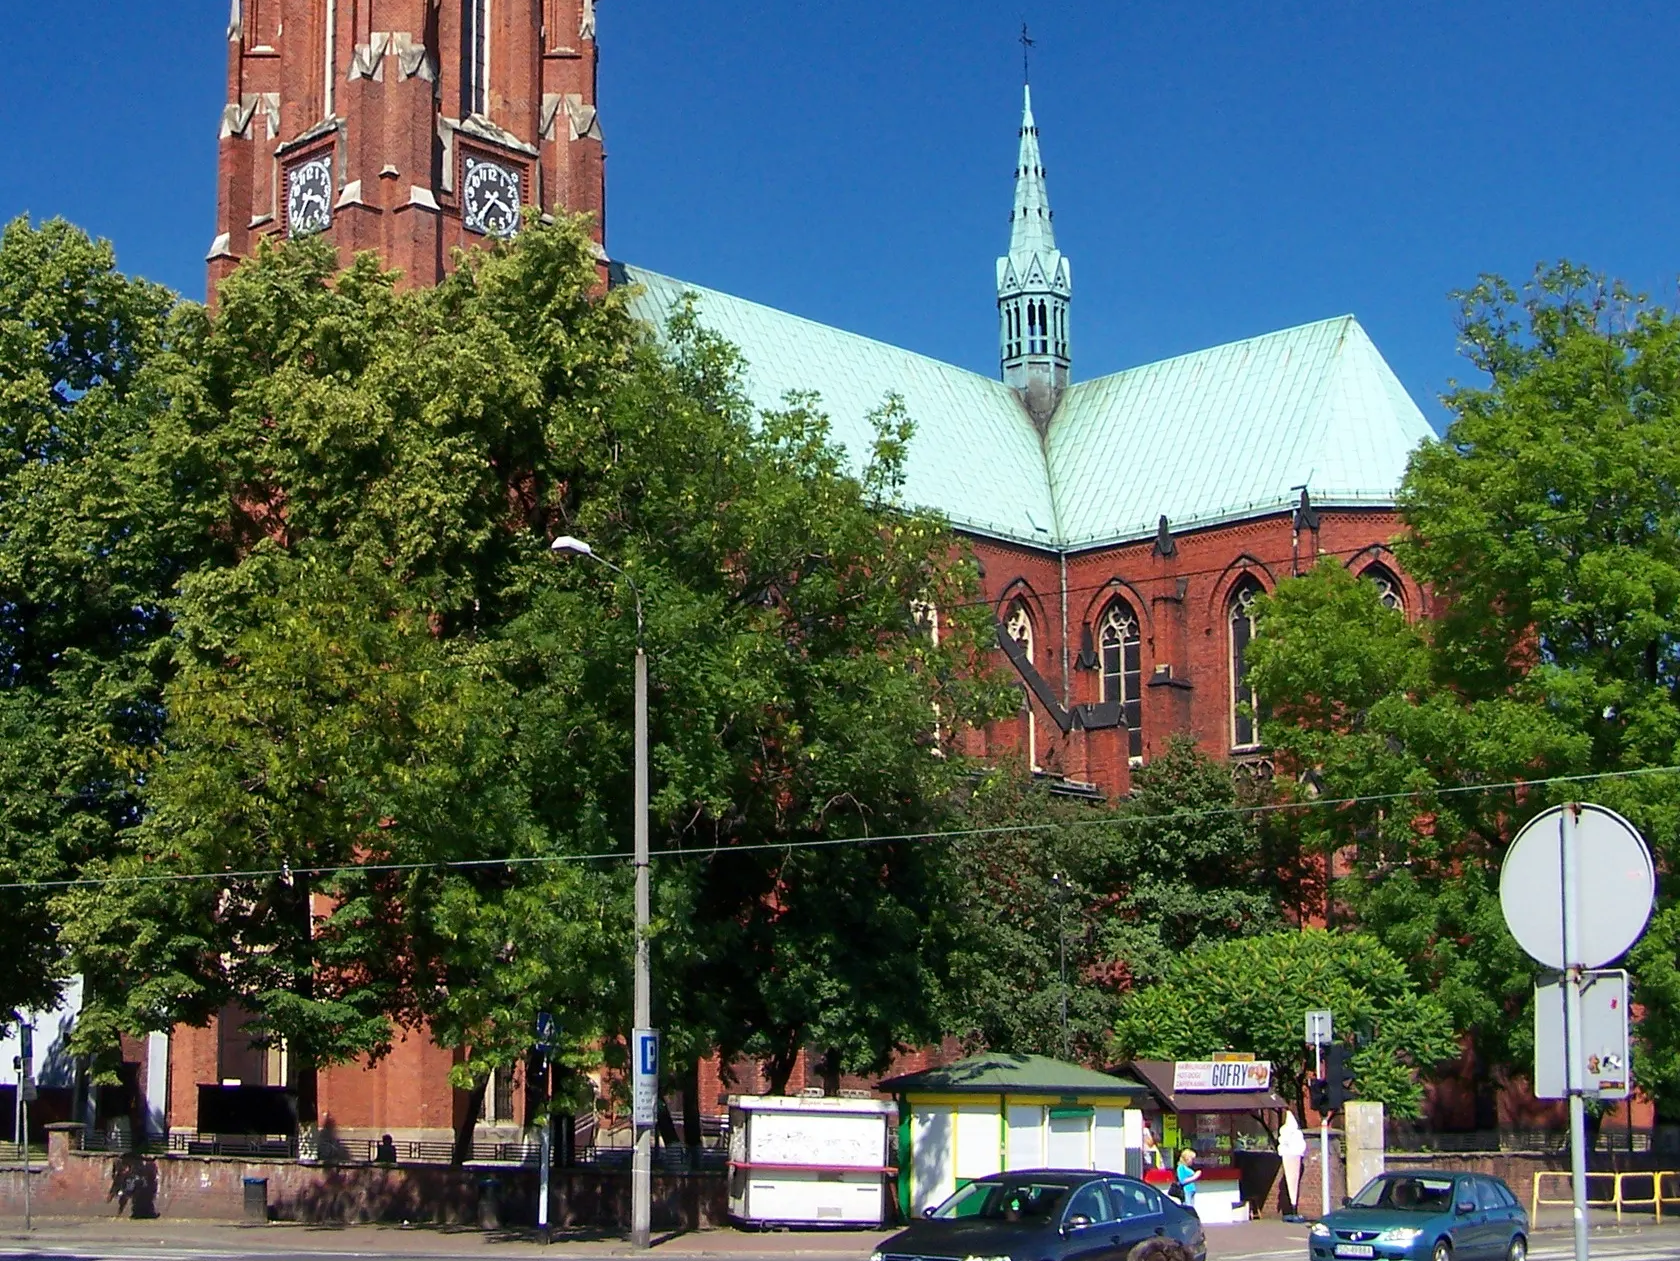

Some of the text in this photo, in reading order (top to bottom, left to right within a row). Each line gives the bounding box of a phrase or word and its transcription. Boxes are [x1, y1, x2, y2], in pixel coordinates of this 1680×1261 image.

[300, 173, 306, 186] 11
[306, 166, 314, 181] 12
[320, 173, 325, 186] 2
[479, 168, 487, 182] 11
[488, 168, 497, 181] 12
[471, 175, 480, 188] 10
[468, 186, 475, 199] 9
[507, 185, 514, 198] 2
[471, 200, 478, 213] 8
[313, 209, 320, 221] 5
[498, 217, 506, 229] 5
[646, 1040, 656, 1071] P
[1212, 1063, 1249, 1087] GOFRY
